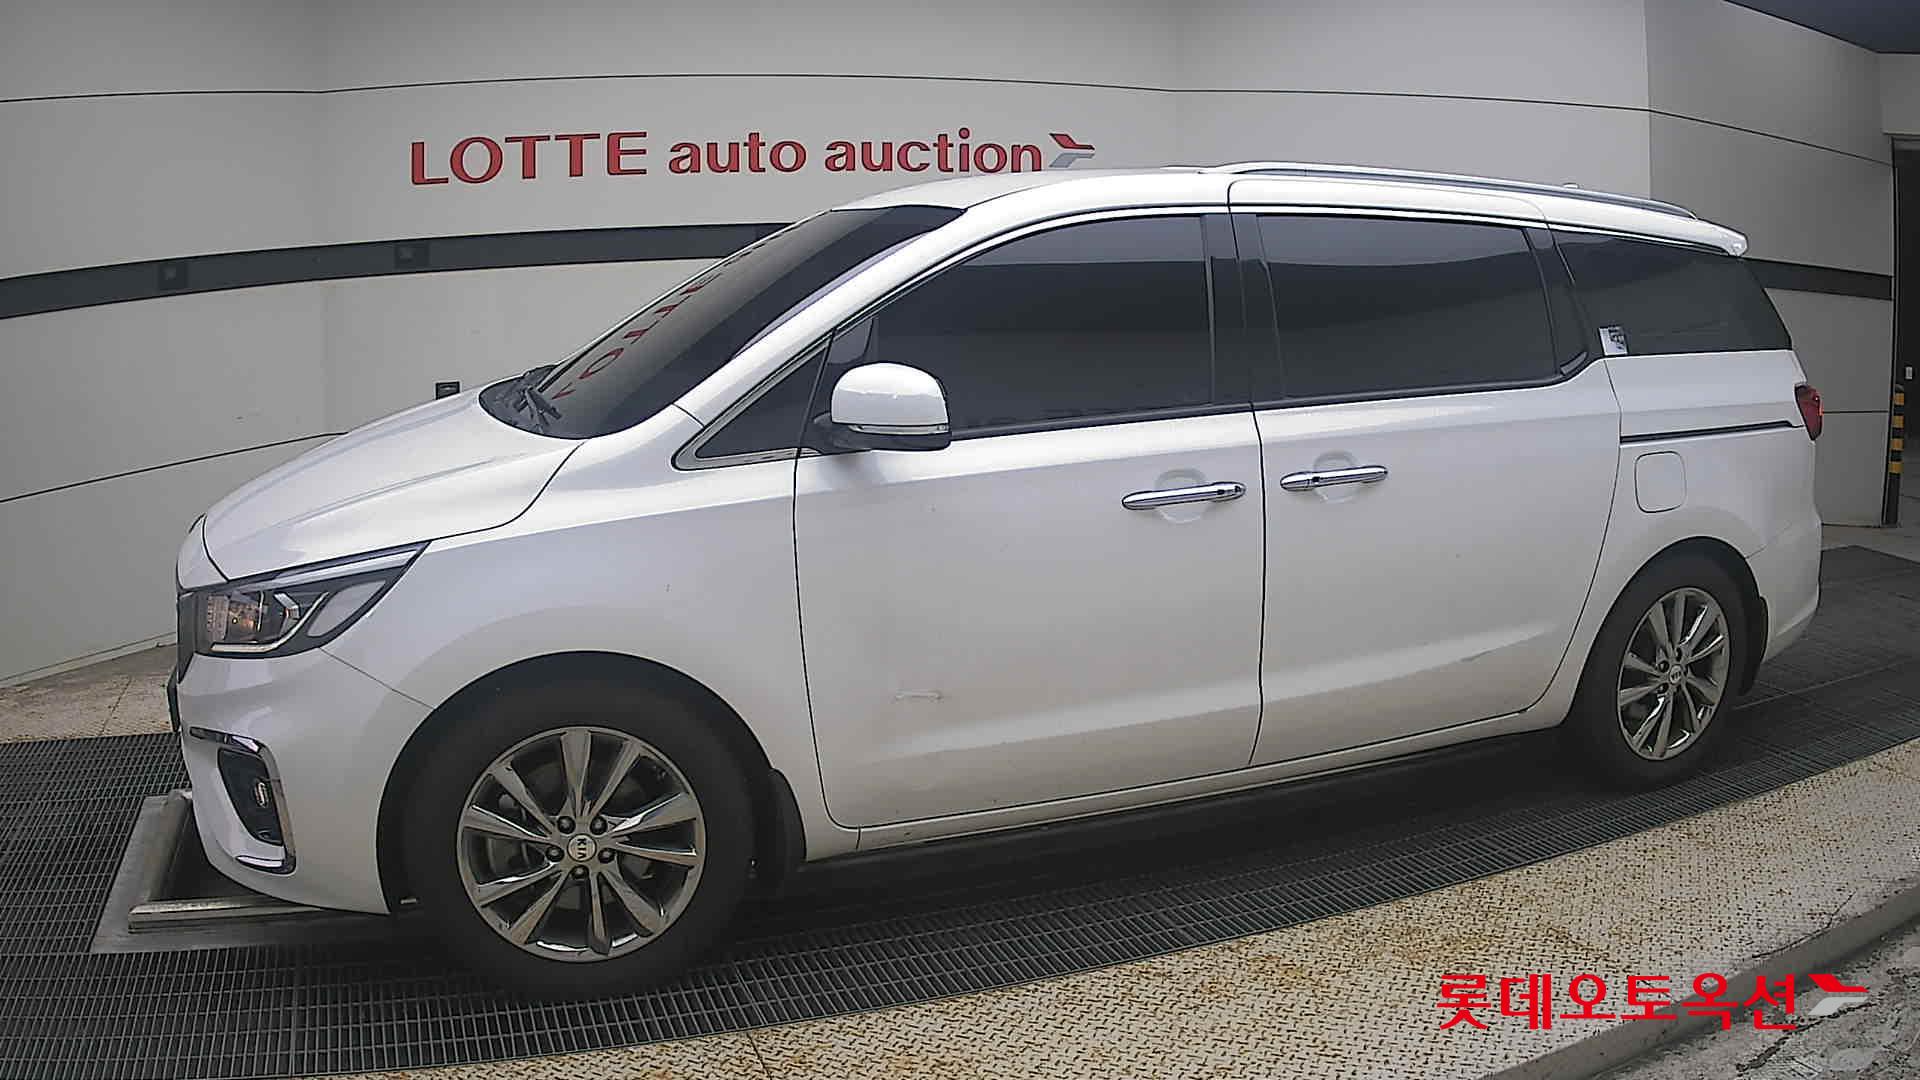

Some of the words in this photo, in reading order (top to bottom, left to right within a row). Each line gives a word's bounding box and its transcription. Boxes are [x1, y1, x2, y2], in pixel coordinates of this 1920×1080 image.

[410, 131, 647, 185] LOTTE
[668, 132, 807, 174] auto
[824, 127, 1042, 173] auction
[576, 837, 588, 860] KIA
